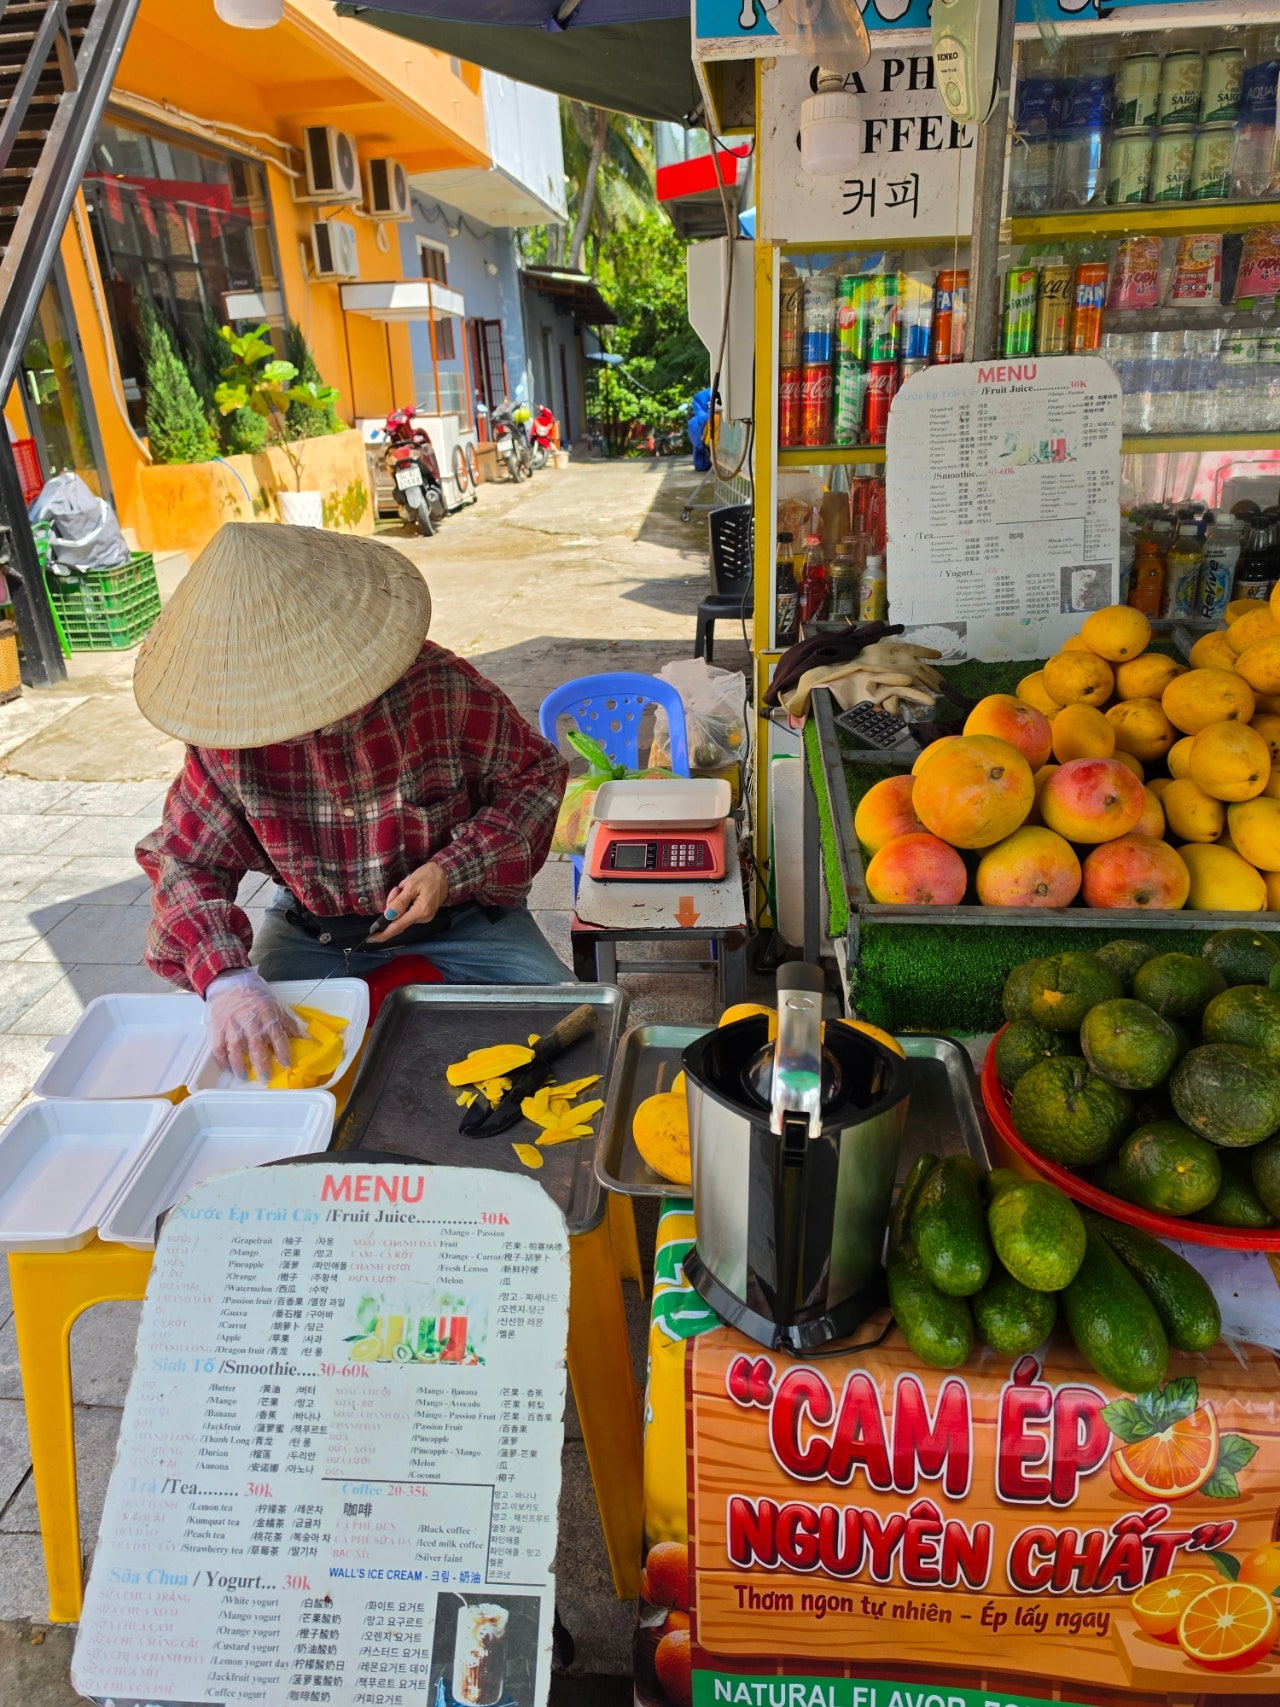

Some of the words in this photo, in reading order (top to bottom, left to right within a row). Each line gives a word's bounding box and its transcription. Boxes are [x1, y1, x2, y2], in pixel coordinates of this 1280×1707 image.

[881, 57, 935, 93] PH
[842, 173, 920, 218] 커피
[1076, 281, 1105, 305] FAN
[977, 364, 1037, 383] MENU
[981, 386, 1007, 395] /Fruit
[321, 1175, 425, 1203] MENU
[229, 1203, 249, 1223] Ép
[255, 1207, 287, 1222] Trái
[292, 1207, 320, 1224] Cây
[326, 1209, 369, 1223] /Fruit
[478, 1212, 510, 1225] 30K
[440, 1229, 469, 1237] /Mango
[231, 1236, 272, 1245] /Grapefruit
[440, 1240, 458, 1248] Fruit
[229, 1249, 258, 1257] /Mango
[438, 1253, 470, 1261] /Orange
[228, 1261, 264, 1269] Pineapple
[437, 1264, 461, 1272] /Fresh
[226, 1272, 256, 1281] /Orange
[436, 1276, 464, 1284] /Melon
[224, 1284, 272, 1293] /Watermelon
[222, 1296, 254, 1305] /Passion
[255, 1297, 272, 1305] fruit
[220, 1309, 247, 1317] /Guava
[219, 1321, 246, 1329] /Carrot
[217, 1333, 241, 1342] /Apple
[215, 1345, 247, 1354] /Dragon
[248, 1346, 264, 1355] fruit
[152, 1359, 186, 1372] Sinh
[320, 1363, 369, 1379] 30-60k
[209, 1384, 236, 1392] /Butter
[416, 1387, 444, 1395] /Mango
[452, 1388, 477, 1396] Banana
[207, 1397, 237, 1406] /Mango
[415, 1399, 443, 1408] /Mango
[205, 1409, 236, 1418] /Banana
[414, 1411, 441, 1420] /Mango
[450, 1412, 476, 1420] Passion
[478, 1413, 496, 1421] Fruit
[203, 1423, 241, 1432] /Jackfruit
[413, 1423, 443, 1431] /Passion
[998, 1354, 1112, 1508] ÉP
[200, 1435, 228, 1444] /Thanh
[230, 1436, 250, 1445] Long
[411, 1435, 449, 1444] /Pineapple
[198, 1448, 228, 1457] /Durian
[410, 1447, 448, 1456] /Pineapple
[456, 1449, 481, 1457] Mango
[196, 1461, 228, 1471] /Annona
[409, 1459, 435, 1467] /Melon
[408, 1471, 440, 1479] /Coconut
[342, 1484, 382, 1496] Coffee
[387, 1485, 429, 1497] 20-35k
[188, 1502, 219, 1512] /Lemon
[221, 1504, 233, 1512] tea
[343, 1503, 373, 1517] 咖啡
[186, 1516, 226, 1527] /Kumquat
[227, 1518, 239, 1526] tea
[184, 1529, 213, 1539] /Peach
[214, 1531, 225, 1539] tea
[418, 1524, 443, 1534] /Black
[447, 1525, 471, 1535] coffee
[416, 1537, 437, 1547] /Iced
[439, 1539, 459, 1548] milk
[461, 1540, 484, 1549] coffee
[728, 1494, 992, 1590] NGUYÊN
[181, 1544, 229, 1555] /Strawberry
[231, 1547, 243, 1555] tea
[415, 1553, 441, 1563] /Silver
[444, 1554, 463, 1563] faint
[147, 1568, 188, 1586] Chua
[282, 1574, 311, 1591] 30k
[368, 1569, 384, 1579] ICE
[387, 1570, 422, 1581] CREAM
[431, 1570, 450, 1584] 크림
[459, 1571, 481, 1584] 奶油
[222, 1596, 250, 1605] /White
[252, 1598, 279, 1607] yogurt
[734, 1585, 793, 1611] Thơm
[801, 1593, 853, 1619] ngon
[861, 1596, 886, 1619] tự
[893, 1601, 951, 1624] nhiên
[981, 1599, 1007, 1632] Ép
[1015, 1605, 1049, 1633] lấy
[1055, 1611, 1111, 1637] ngay
[219, 1611, 251, 1621] /Mango
[252, 1613, 281, 1622] yogurt
[216, 1626, 250, 1636] /Orange
[252, 1628, 280, 1637] yogurt
[213, 1641, 249, 1651] /Custard
[251, 1643, 279, 1653] yogurt
[210, 1656, 243, 1665] /Lemon
[244, 1658, 272, 1669] yogurt
[207, 1672, 250, 1682] /Jackfruit
[252, 1674, 279, 1684] yogurt
[205, 1688, 236, 1697] /Coffee
[237, 1689, 266, 1699] yogurt
[714, 1678, 838, 1707] NATURAL
